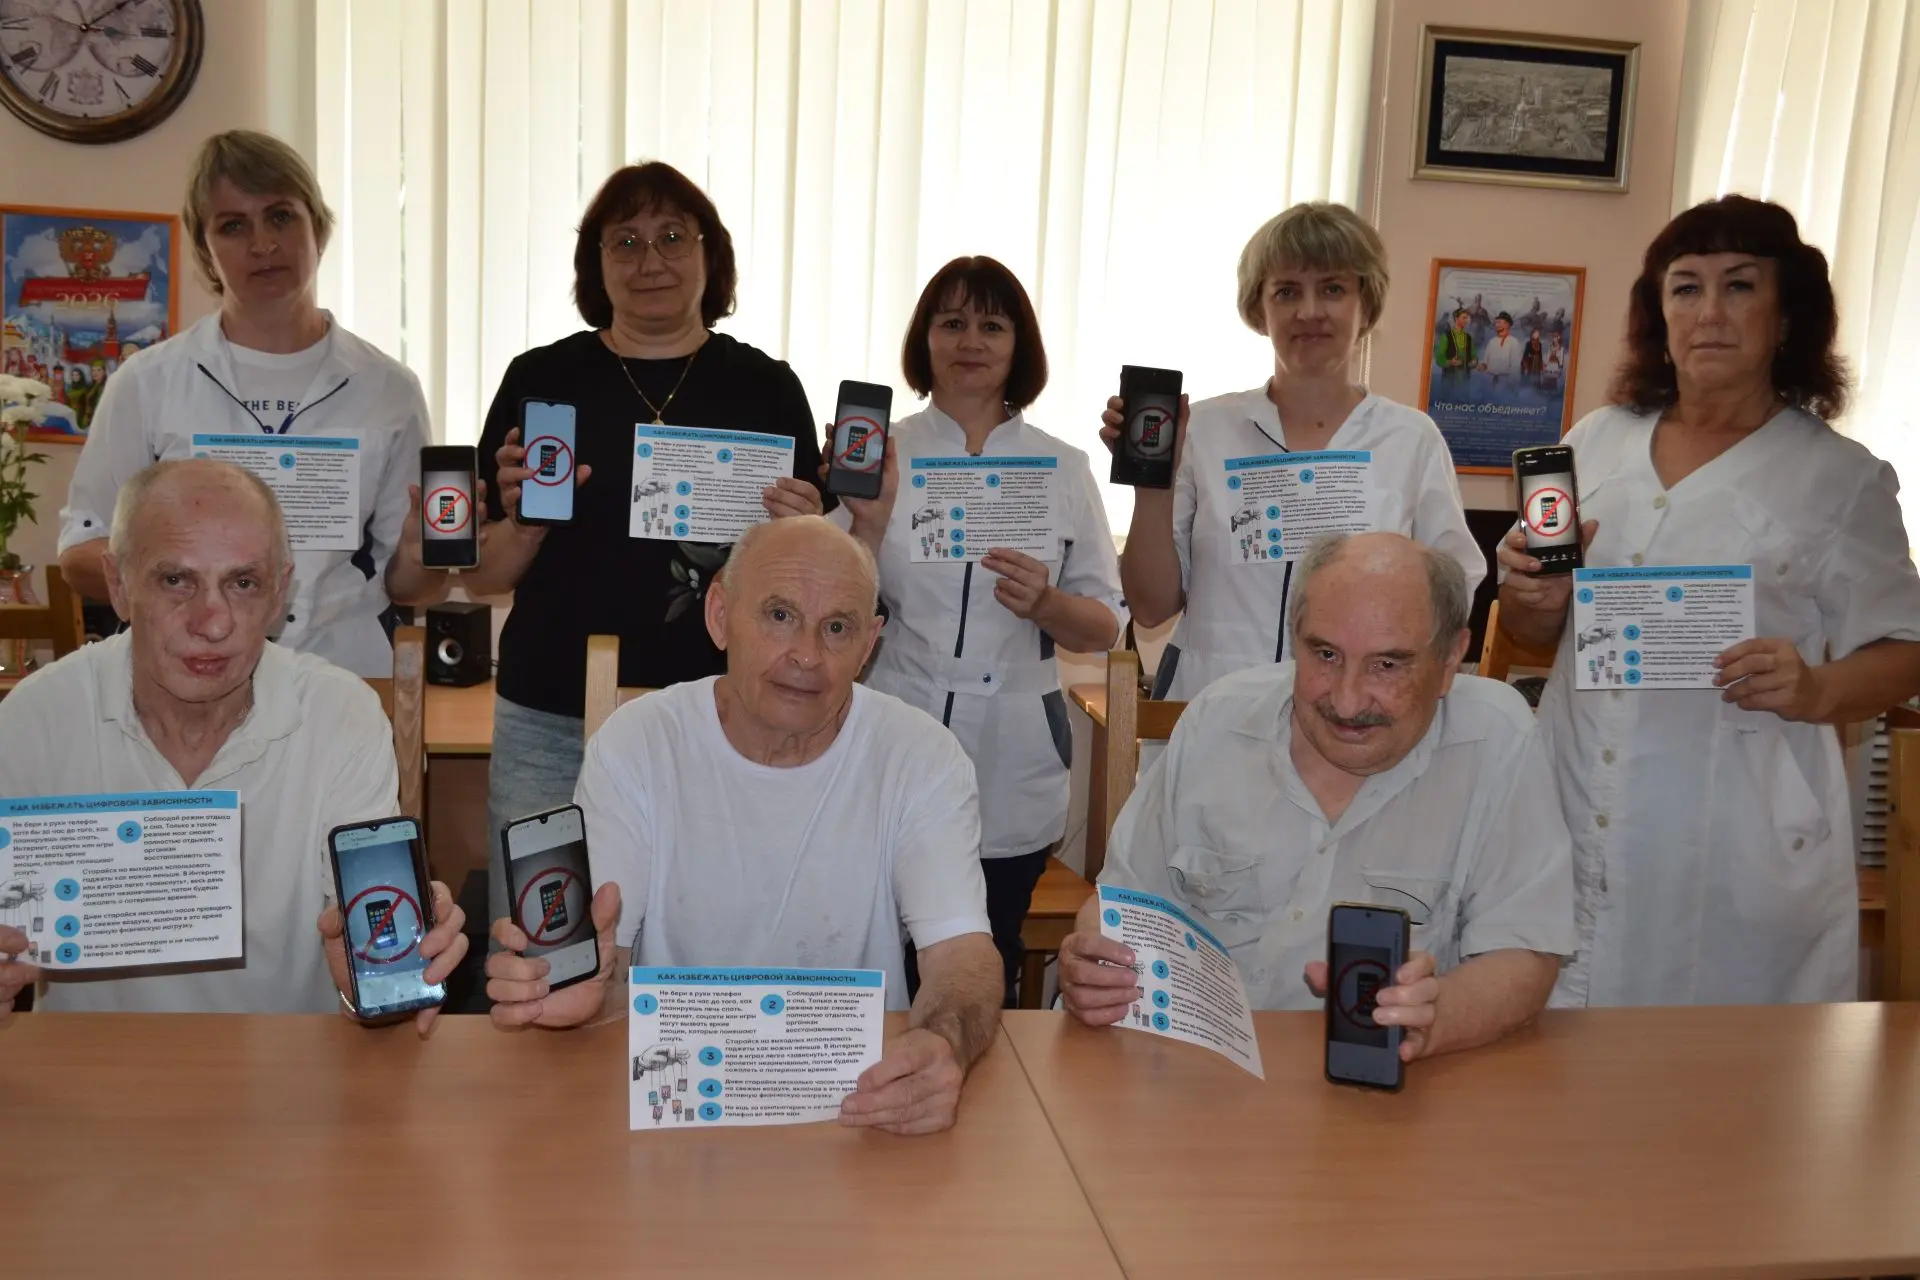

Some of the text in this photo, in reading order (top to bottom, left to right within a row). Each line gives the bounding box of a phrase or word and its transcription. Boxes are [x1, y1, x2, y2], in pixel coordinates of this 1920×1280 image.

[56, 292, 120, 310] 2026
[243, 400, 301, 412] THE BE
[1434, 402, 1547, 415] Что нас объединяет?
[31, 802, 85, 810] ИЗБЕЖАТЬ
[86, 800, 140, 809] ЦИФРОВОЙ
[126, 828, 134, 837] 2
[64, 885, 71, 894] 3
[64, 922, 72, 931] 4
[64, 948, 72, 958] 5
[1158, 965, 1164, 974] 3
[644, 1000, 648, 1008] 1
[769, 1000, 776, 1009] 2
[1158, 1017, 1164, 1025] 5
[707, 1052, 714, 1060] 3
[706, 1084, 714, 1092] 4
[706, 1107, 714, 1116] 5
